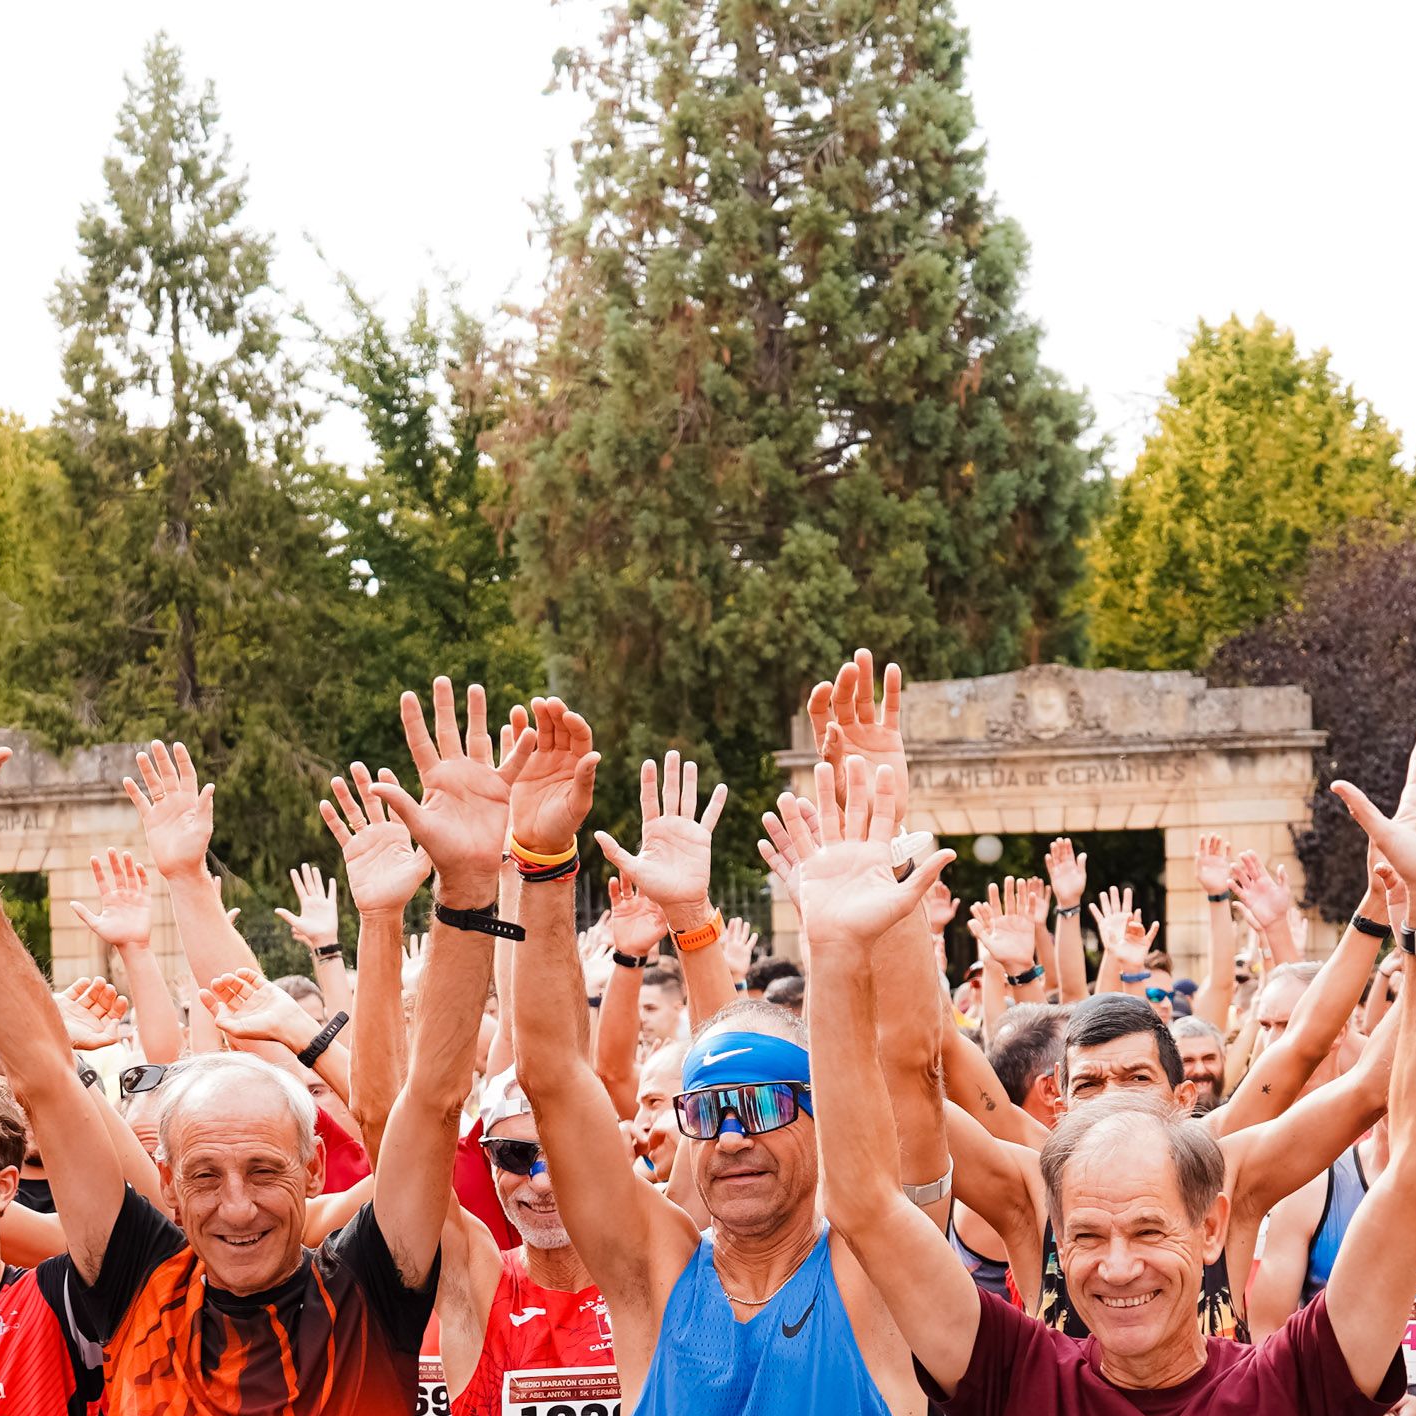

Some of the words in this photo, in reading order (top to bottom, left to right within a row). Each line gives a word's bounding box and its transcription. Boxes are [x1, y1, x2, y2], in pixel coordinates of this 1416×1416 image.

[913, 766, 1019, 788] ALAMEDA
[1027, 771, 1048, 786] DE
[541, 1378, 577, 1388] MARATÓN
[578, 1378, 606, 1386] CIUDAD
[546, 1389, 571, 1398] ANTÓN
[592, 1387, 617, 1396] FERMÍN
